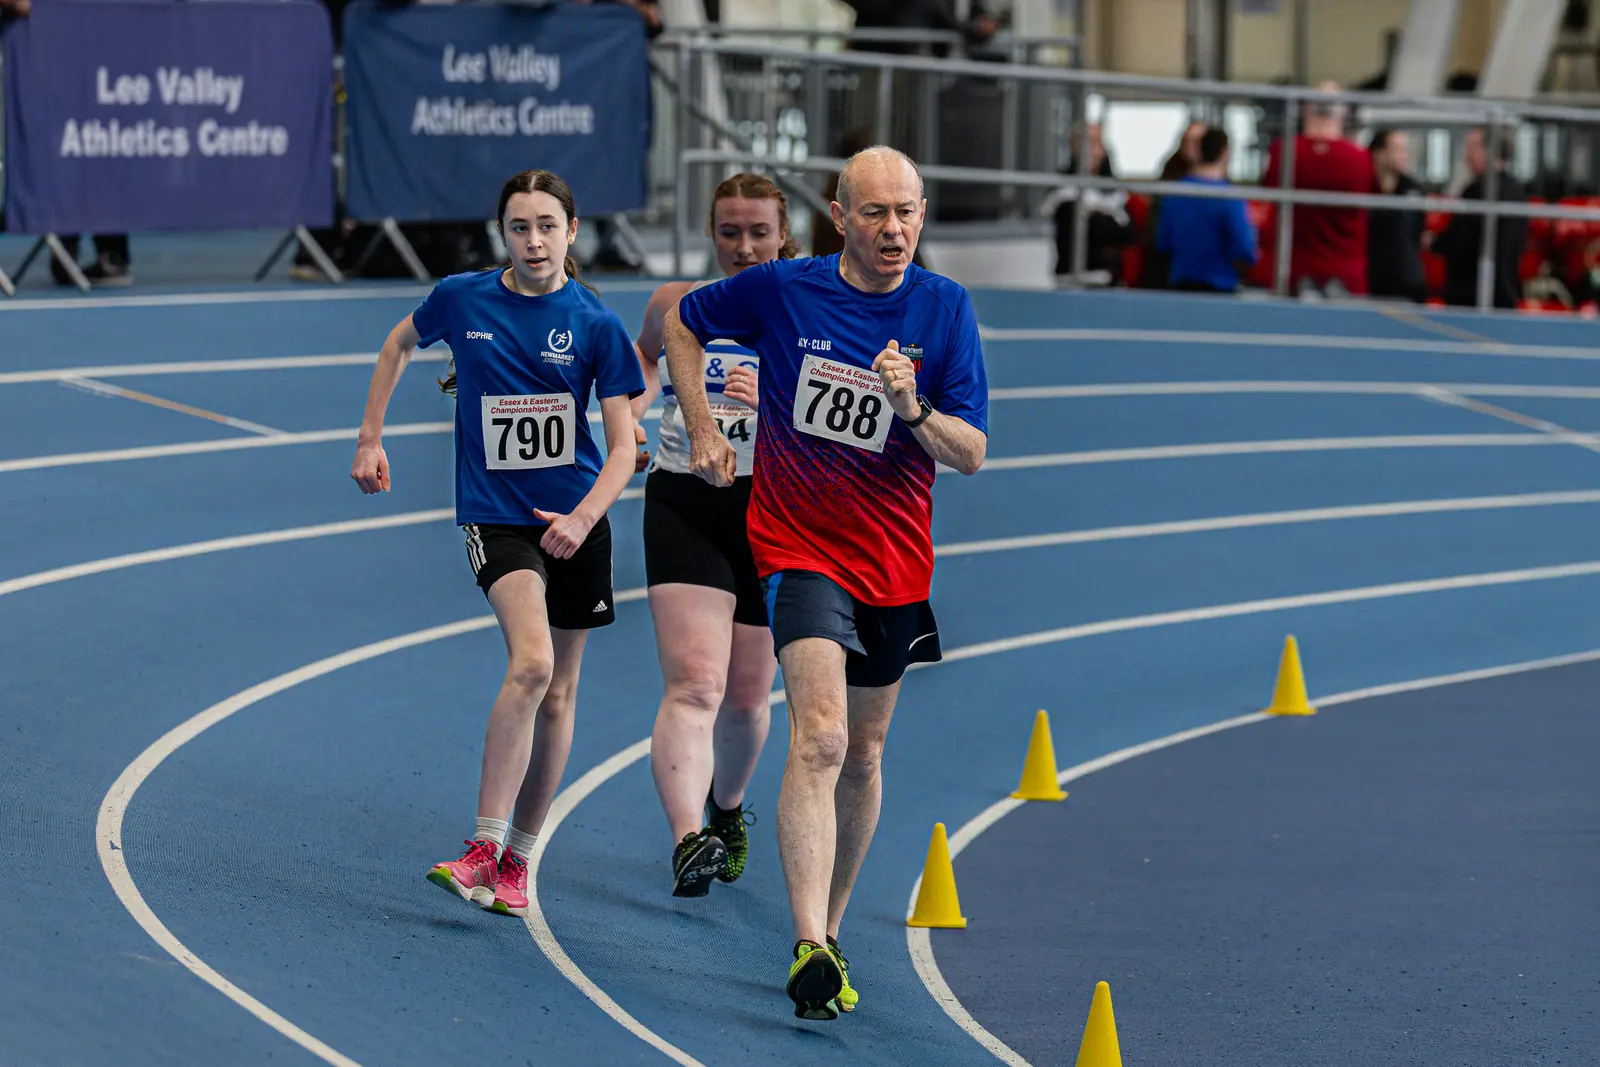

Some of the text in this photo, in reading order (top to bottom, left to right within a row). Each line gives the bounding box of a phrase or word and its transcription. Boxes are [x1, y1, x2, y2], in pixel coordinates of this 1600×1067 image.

[442, 43, 559, 91] Lee Valley
[96, 66, 244, 114] Lee Valley
[411, 96, 594, 136] Athletics Centre
[60, 118, 288, 157] Athletics Centre
[466, 331, 493, 341] SOPHIE
[540, 351, 574, 362] NEWMARKET
[706, 358, 725, 378] &
[810, 368, 885, 394] Championships 202
[821, 362, 846, 374] Essex
[853, 370, 883, 385] Eastern
[490, 404, 568, 415] Championships 2026
[499, 398, 521, 407] Essex
[805, 379, 882, 439] 788
[492, 415, 564, 461] 790
